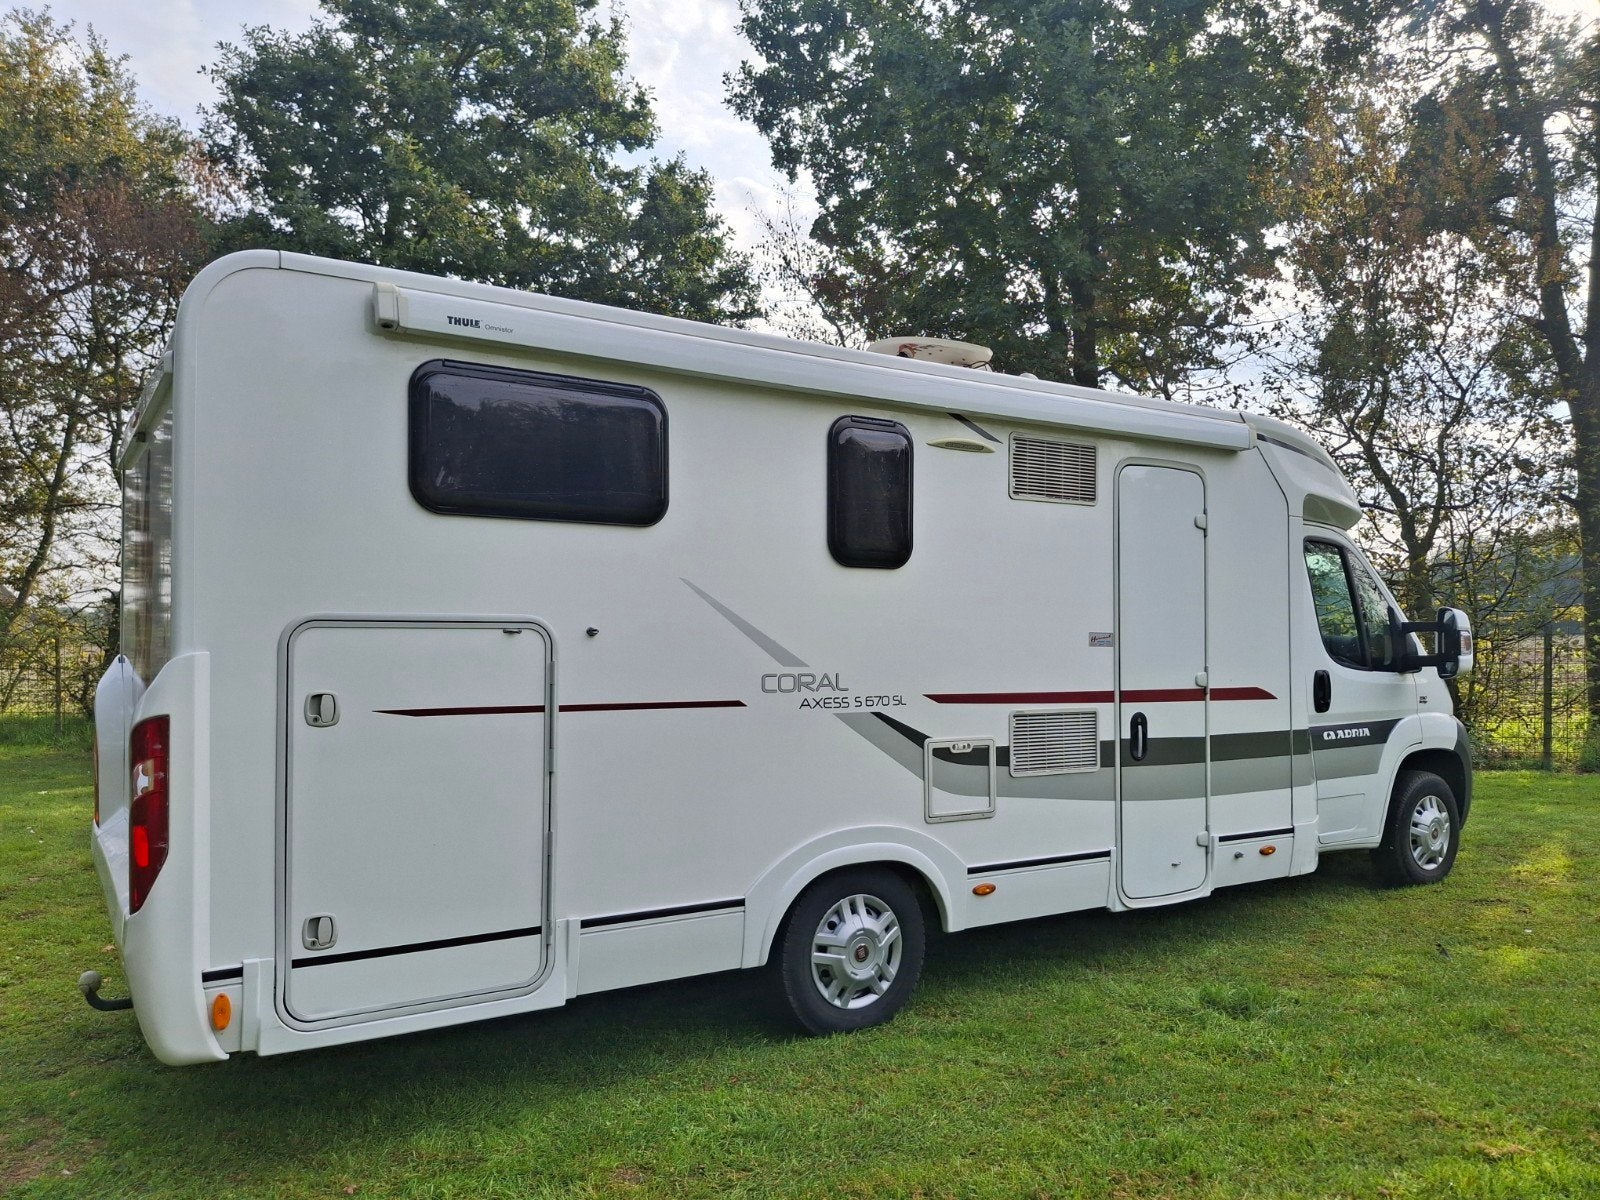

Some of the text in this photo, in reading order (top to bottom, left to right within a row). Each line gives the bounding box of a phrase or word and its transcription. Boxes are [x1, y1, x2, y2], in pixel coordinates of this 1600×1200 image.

[447, 315, 480, 328] THULE
[761, 672, 849, 693] CORAL
[799, 695, 907, 709] AXESS S 670 SL
[1337, 728, 1370, 739] ADRIA
